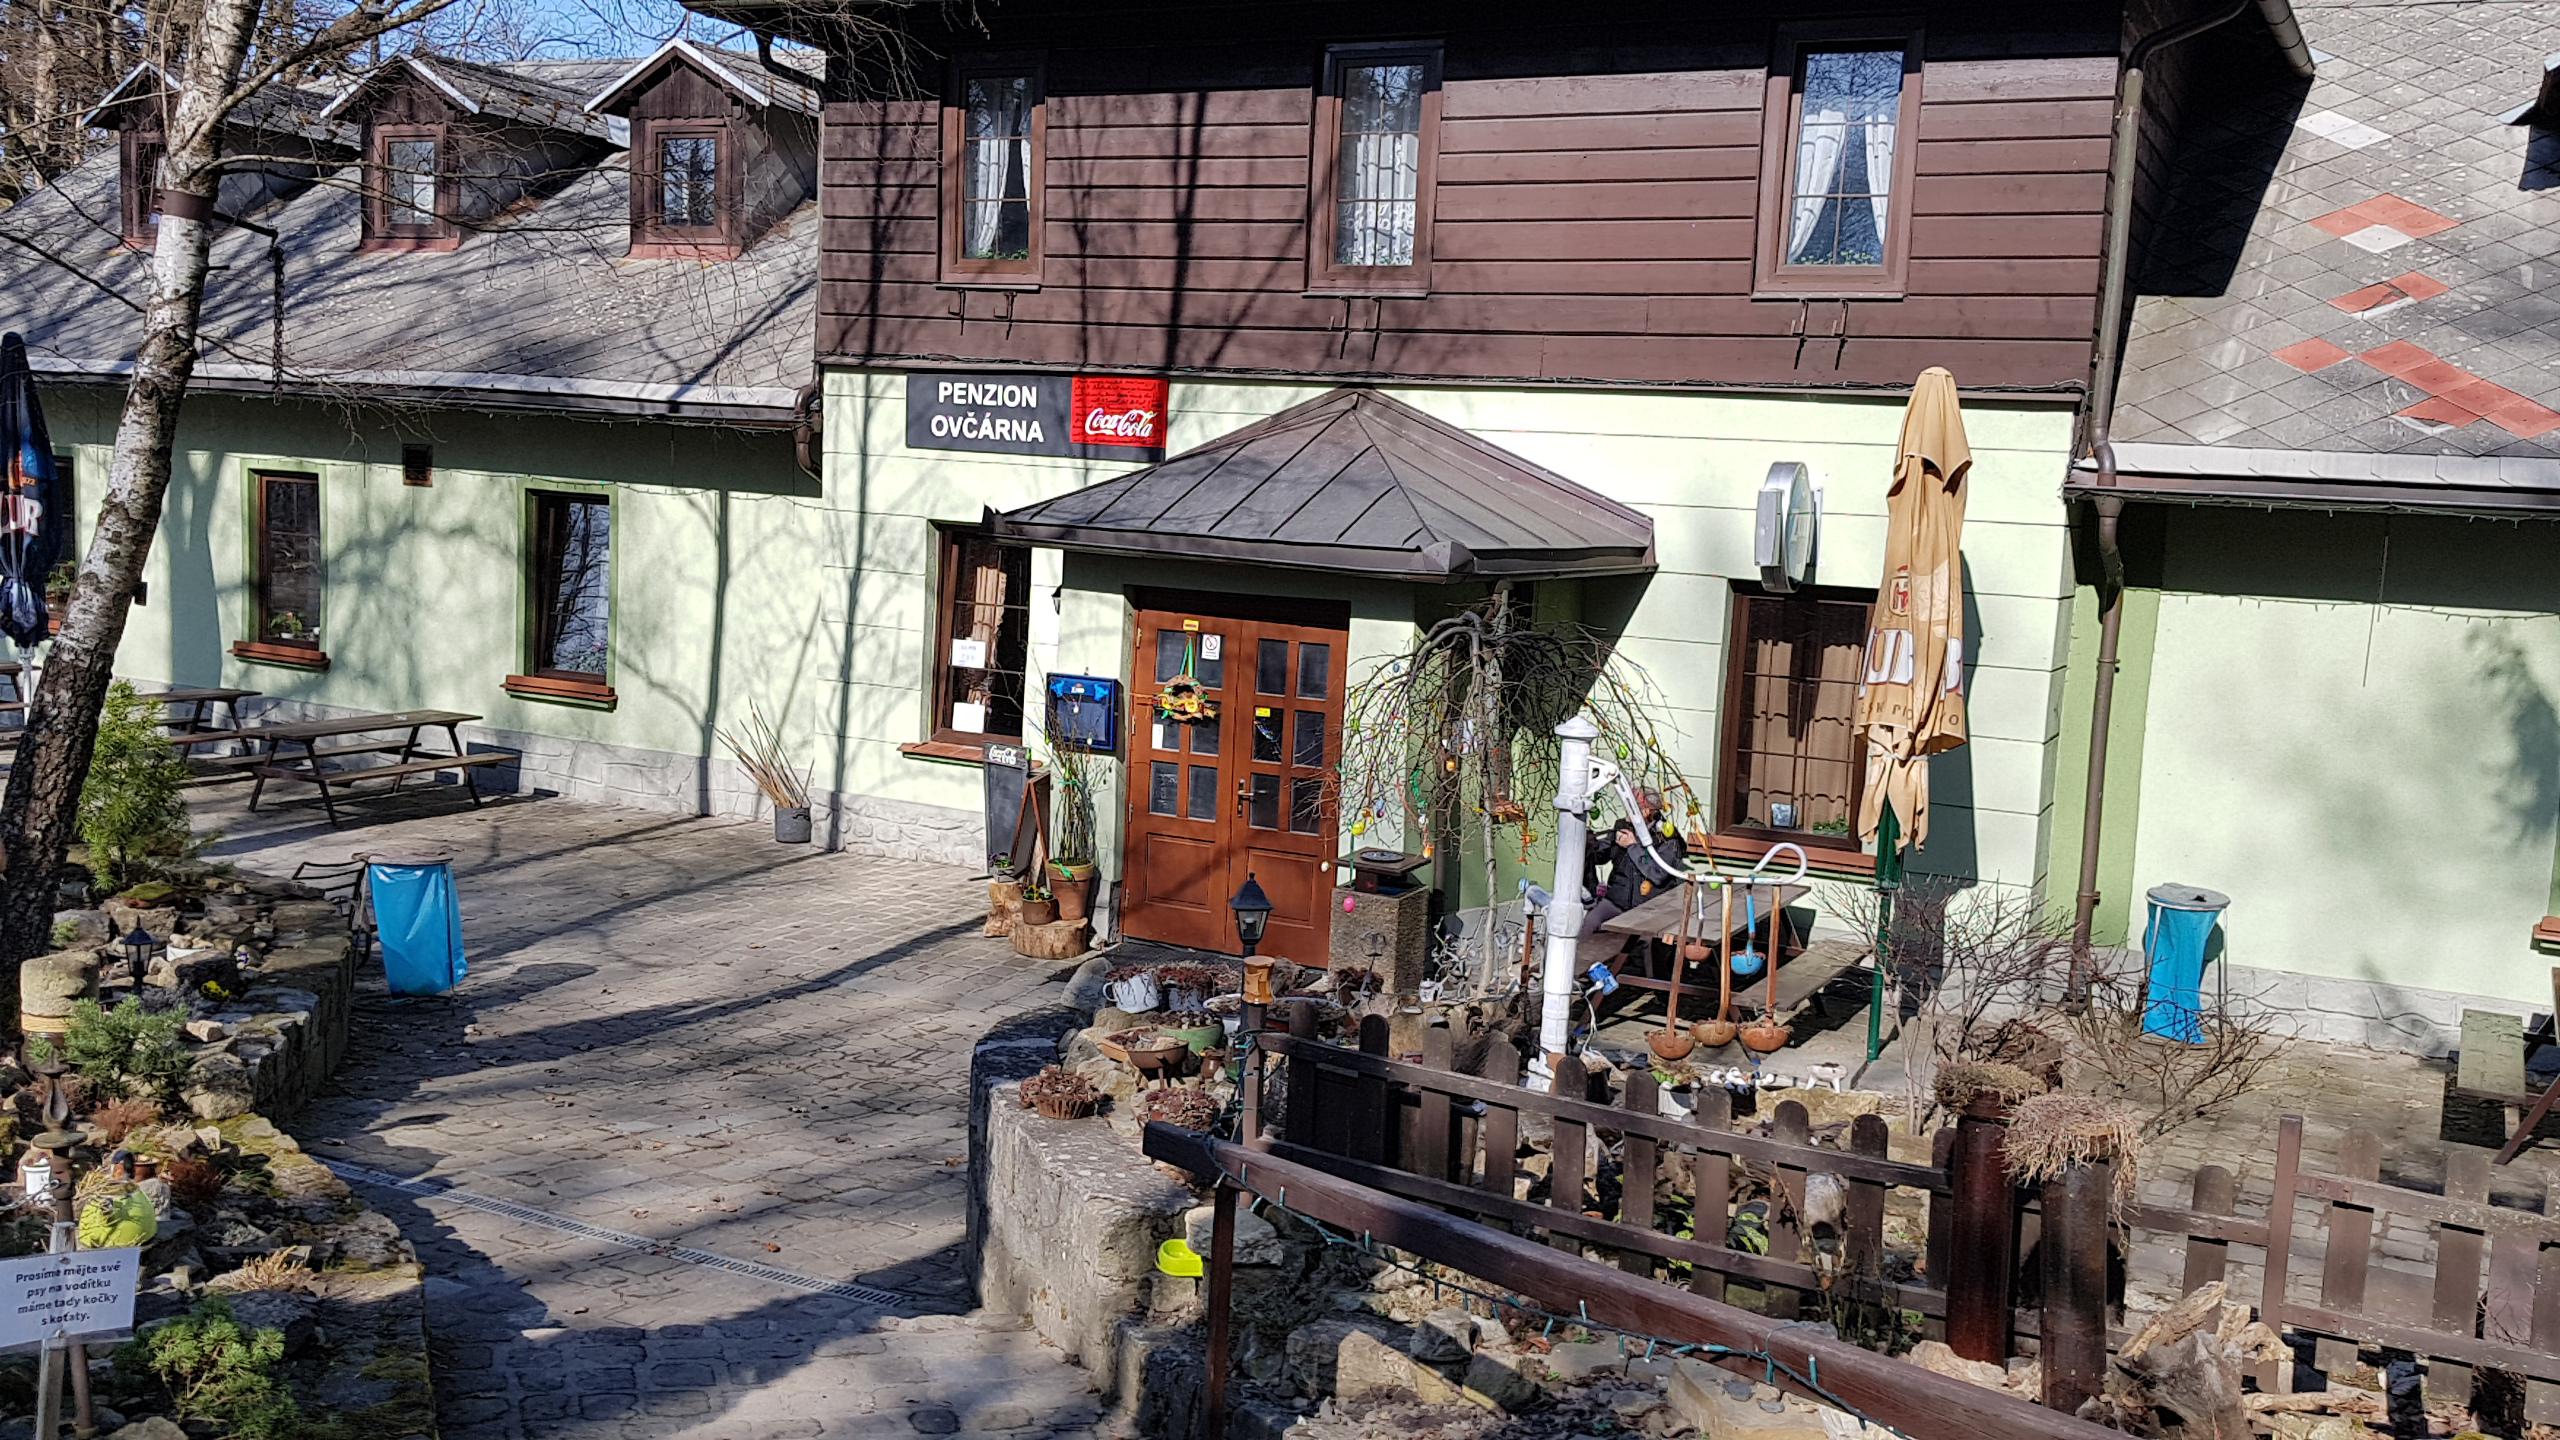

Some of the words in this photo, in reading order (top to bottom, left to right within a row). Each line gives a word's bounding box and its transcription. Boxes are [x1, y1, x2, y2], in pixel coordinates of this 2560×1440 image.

[938, 382, 1037, 408] PENZION
[930, 411, 1044, 442] OVČÁRNA
[1084, 407, 1157, 437] Coca-Cola
[16, 1267, 61, 1283] Prosíme
[63, 1264, 98, 1277] mějte
[100, 1261, 121, 1272] své
[26, 1286, 47, 1299] psy
[48, 1284, 62, 1293] na
[65, 1278, 111, 1291] vodítku
[17, 1301, 52, 1314] máme
[54, 1296, 81, 1308] tady
[83, 1293, 119, 1305] kočky
[41, 1317, 47, 1326] s
[49, 1311, 90, 1324] koťaty.
